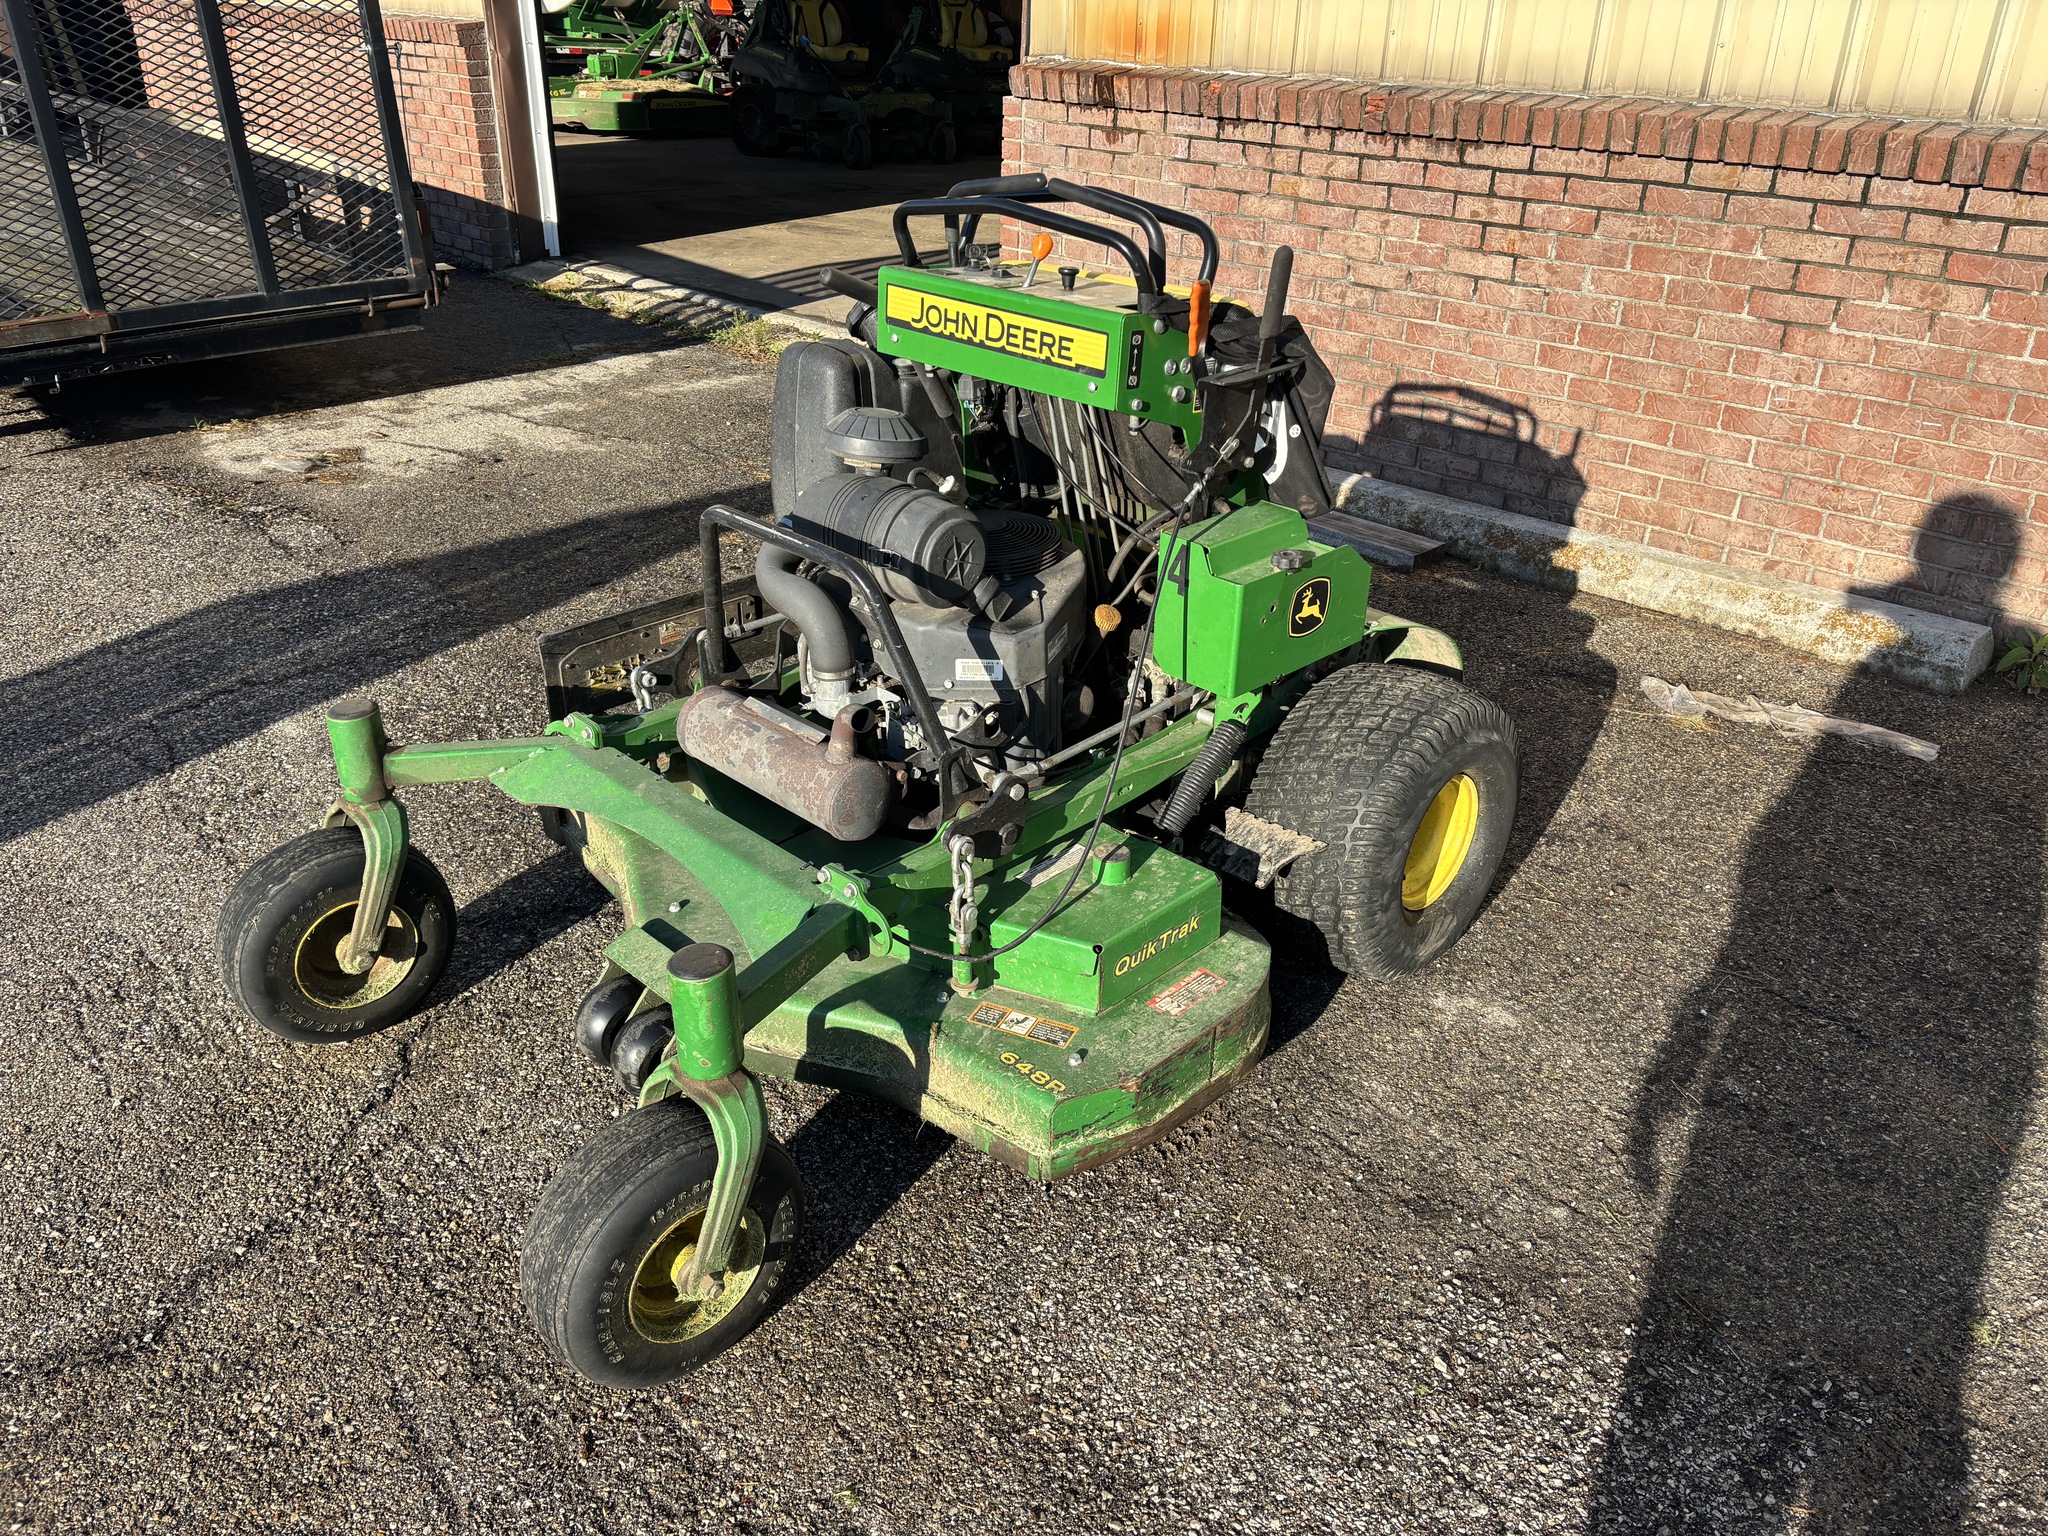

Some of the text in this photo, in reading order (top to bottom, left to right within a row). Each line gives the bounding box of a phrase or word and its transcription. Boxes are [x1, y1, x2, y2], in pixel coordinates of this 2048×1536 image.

[654, 100, 673, 109] JOHN
[911, 297, 1076, 363] JOHN DEERE
[1167, 544, 1188, 597] 4
[1113, 912, 1202, 978] QuikTrak
[274, 1001, 366, 1033] CARLISLE
[998, 1051, 1068, 1095] 648R
[596, 1258, 627, 1364] CARLISLE
